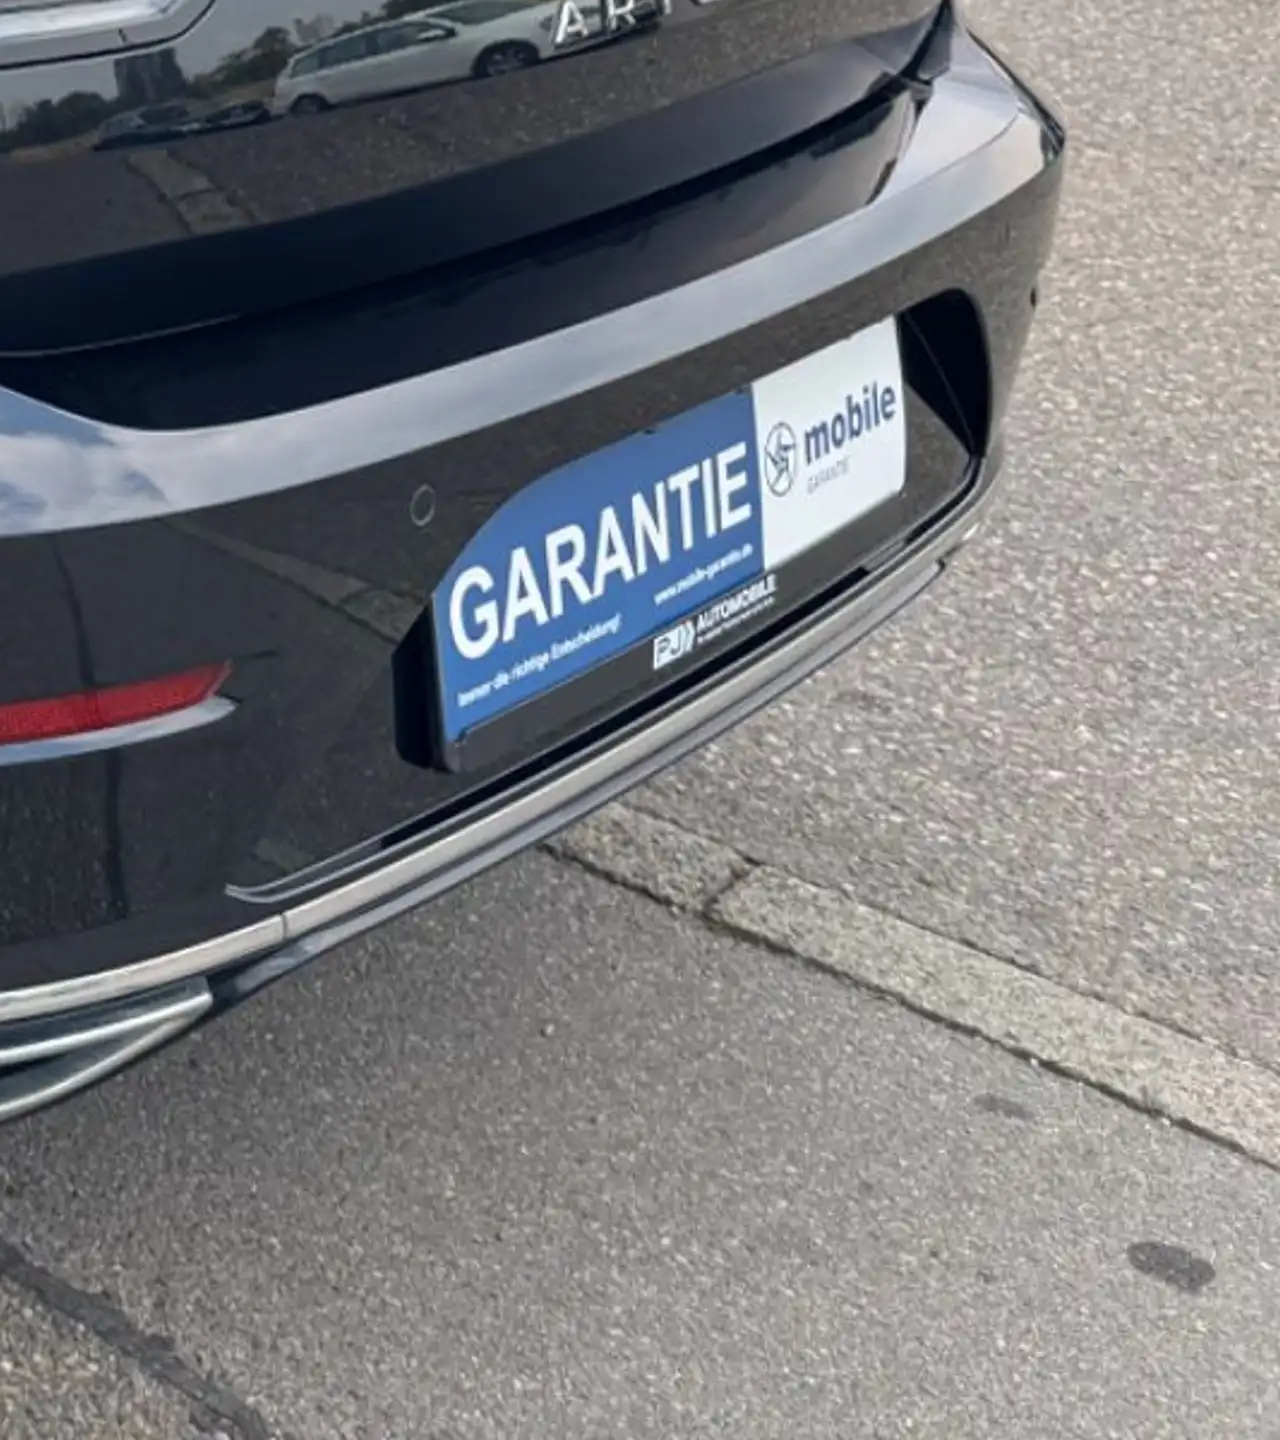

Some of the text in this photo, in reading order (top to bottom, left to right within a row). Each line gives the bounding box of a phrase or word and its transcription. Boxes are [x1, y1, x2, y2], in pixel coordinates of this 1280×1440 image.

[804, 380, 896, 467] mobile
[449, 442, 752, 660] GARANTIE
[697, 573, 777, 633] AUTOMOBILE
